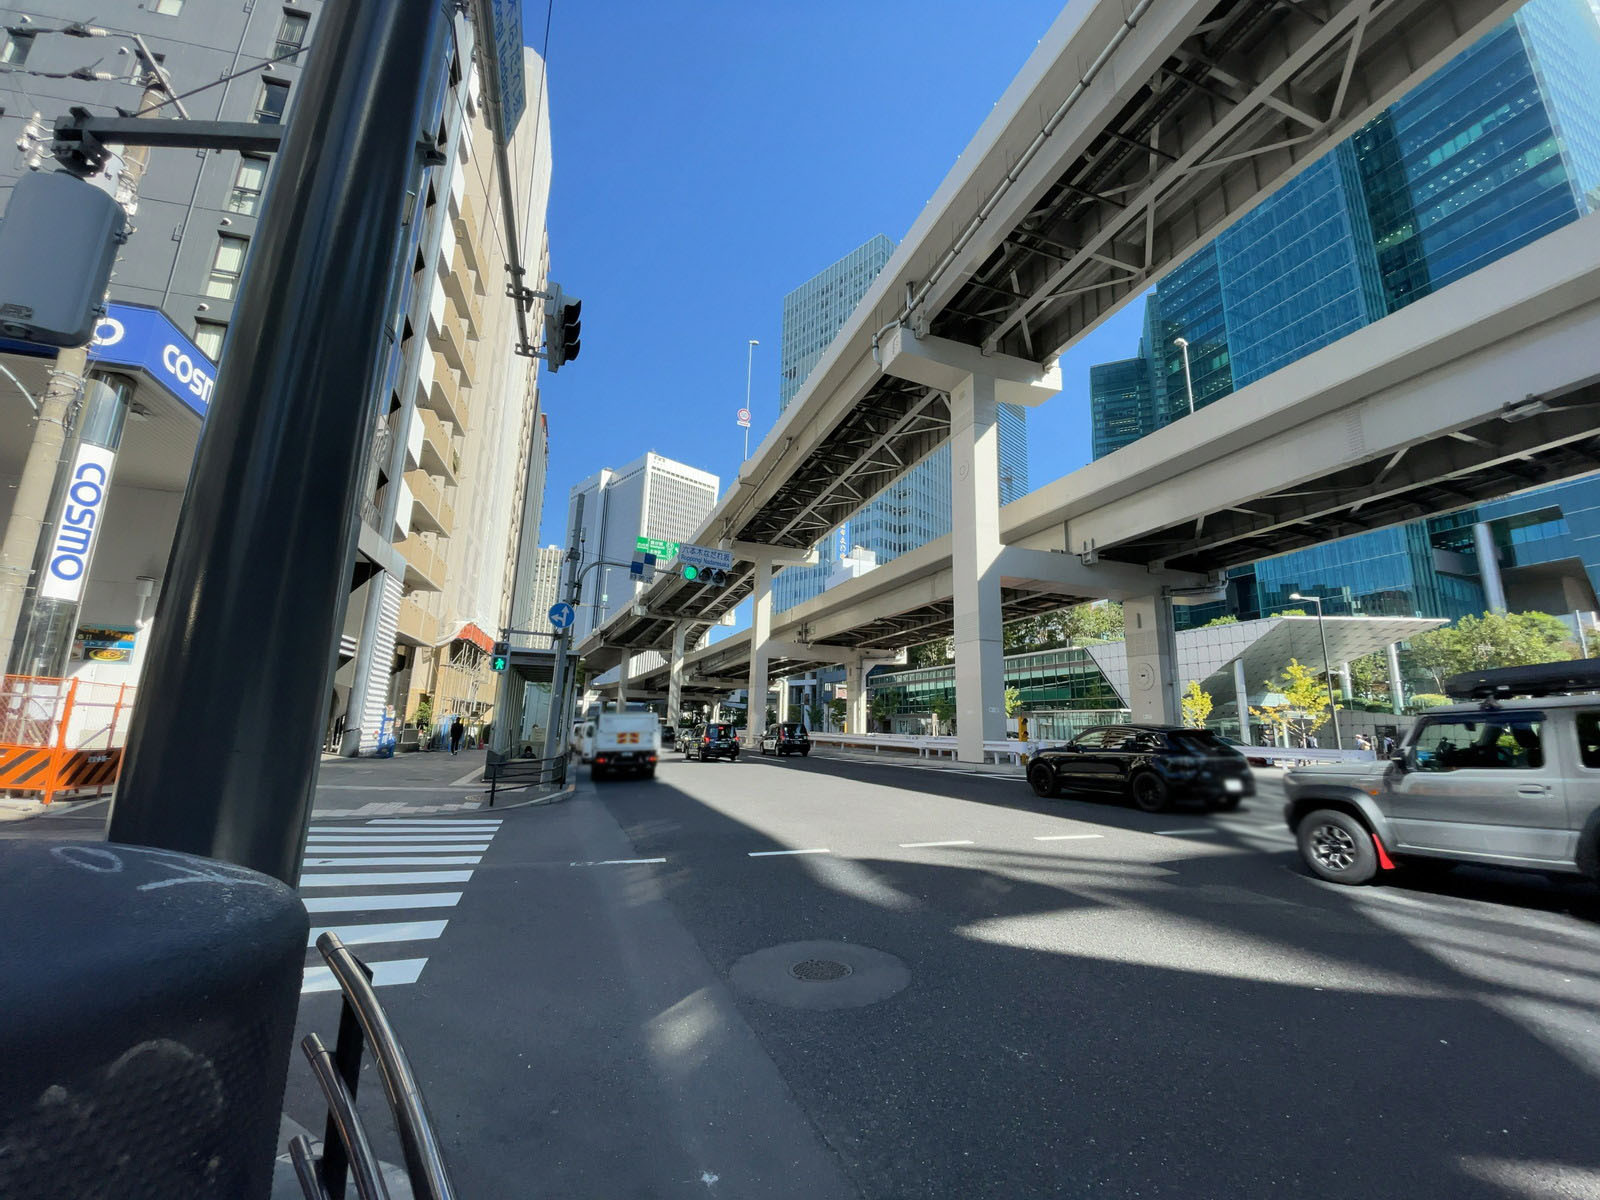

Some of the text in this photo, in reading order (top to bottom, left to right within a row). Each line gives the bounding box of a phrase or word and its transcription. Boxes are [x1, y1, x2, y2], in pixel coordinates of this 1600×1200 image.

[51, 462, 106, 581] COSMO
[680, 554, 703, 564] Roppongi
[681, 546, 730, 562] 六本木なだれ坂
